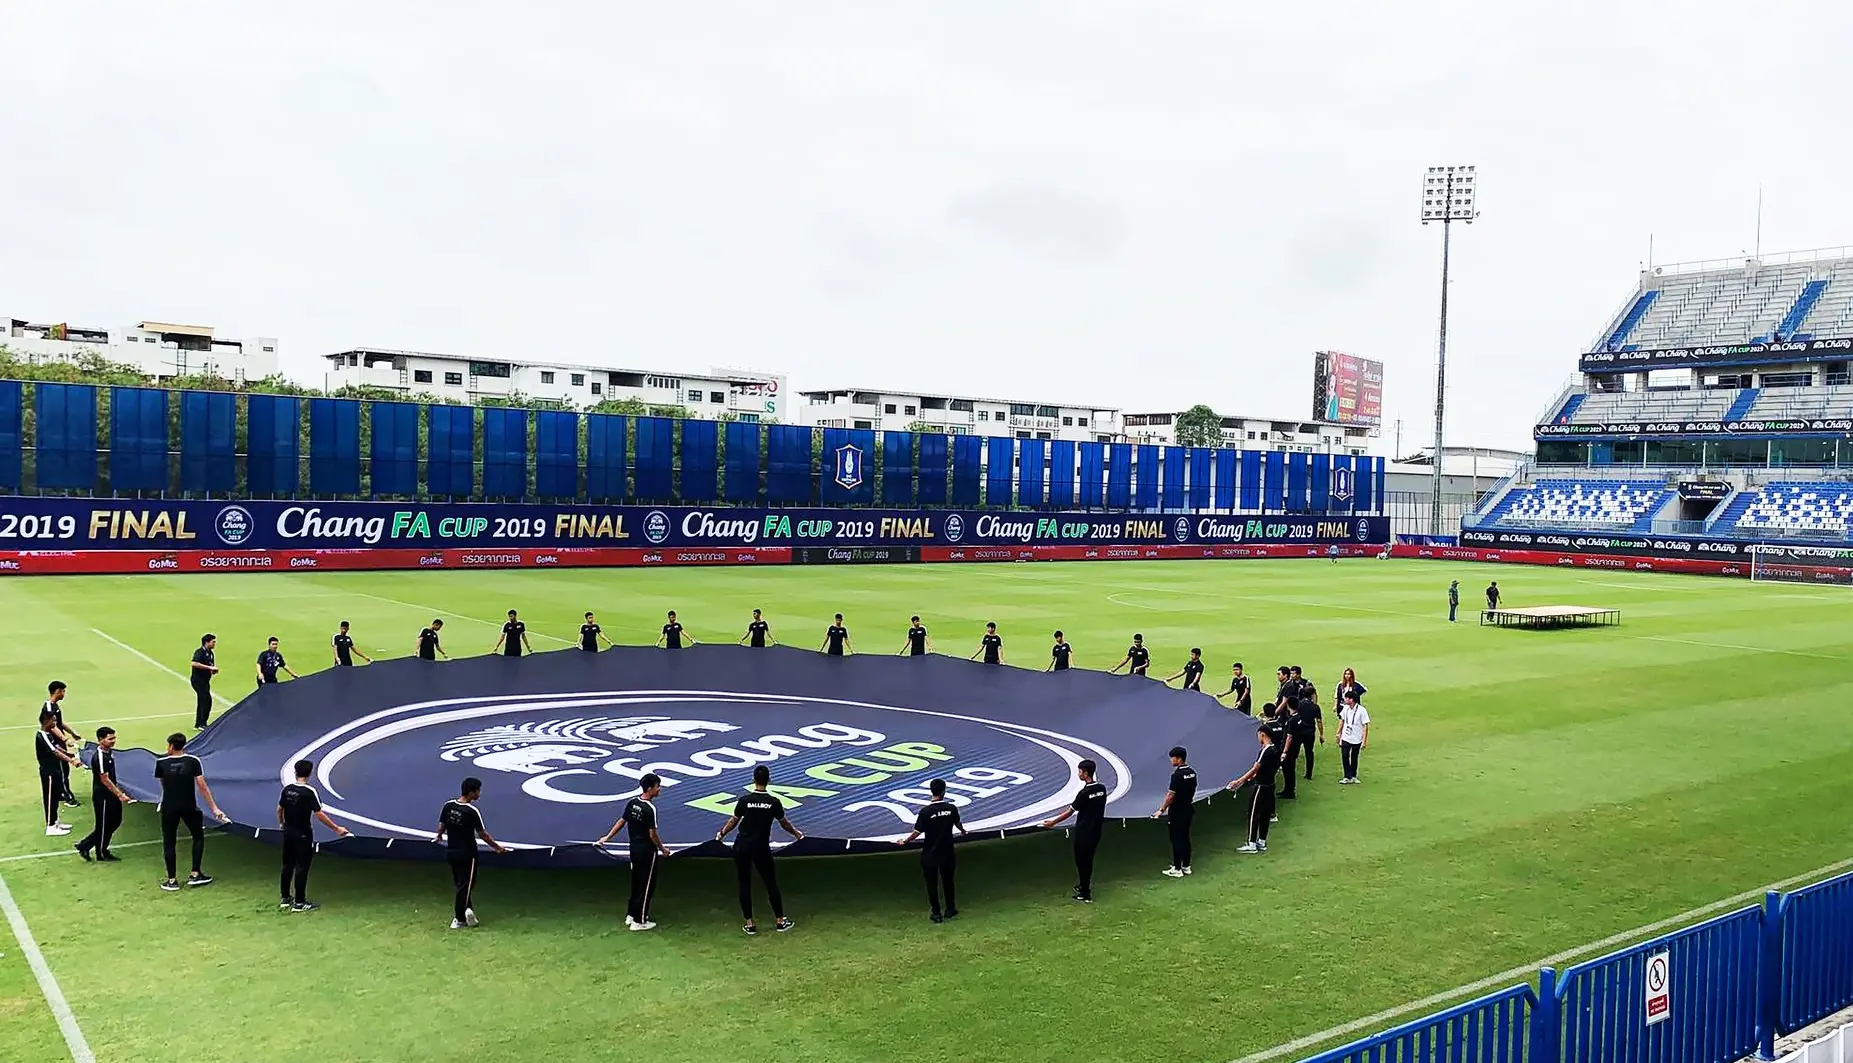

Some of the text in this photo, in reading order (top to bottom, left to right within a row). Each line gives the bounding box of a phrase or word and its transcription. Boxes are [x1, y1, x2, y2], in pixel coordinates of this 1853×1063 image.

[0, 510, 196, 539] 2019 FINAL
[222, 521, 246, 530] Chang
[277, 507, 630, 544] Chang FA CUP 2019 FINAL
[682, 511, 935, 543] Chang FA CUP 2019 FINAL
[976, 514, 1034, 542] Chang
[1036, 518, 1058, 539] FA
[1062, 522, 1089, 538] CUP
[1091, 523, 1121, 539] 2019
[1124, 520, 1167, 539] FINAL
[1197, 518, 1244, 542] Chang
[1245, 520, 1264, 538] FA
[1266, 523, 1288, 538] CUP
[1289, 524, 1314, 538] 2019
[1316, 521, 1351, 538] FINAL
[828, 548, 852, 561] Chang
[853, 550, 862, 560] FA
[876, 550, 889, 560] 2019
[1587, 537, 1610, 548] Chang
[1666, 540, 1692, 552] Chang
[1710, 543, 1738, 554] Chang
[522, 722, 887, 804] Chang
[684, 784, 841, 816] FA
[804, 742, 955, 785] CUP
[842, 767, 1033, 825] 2019
